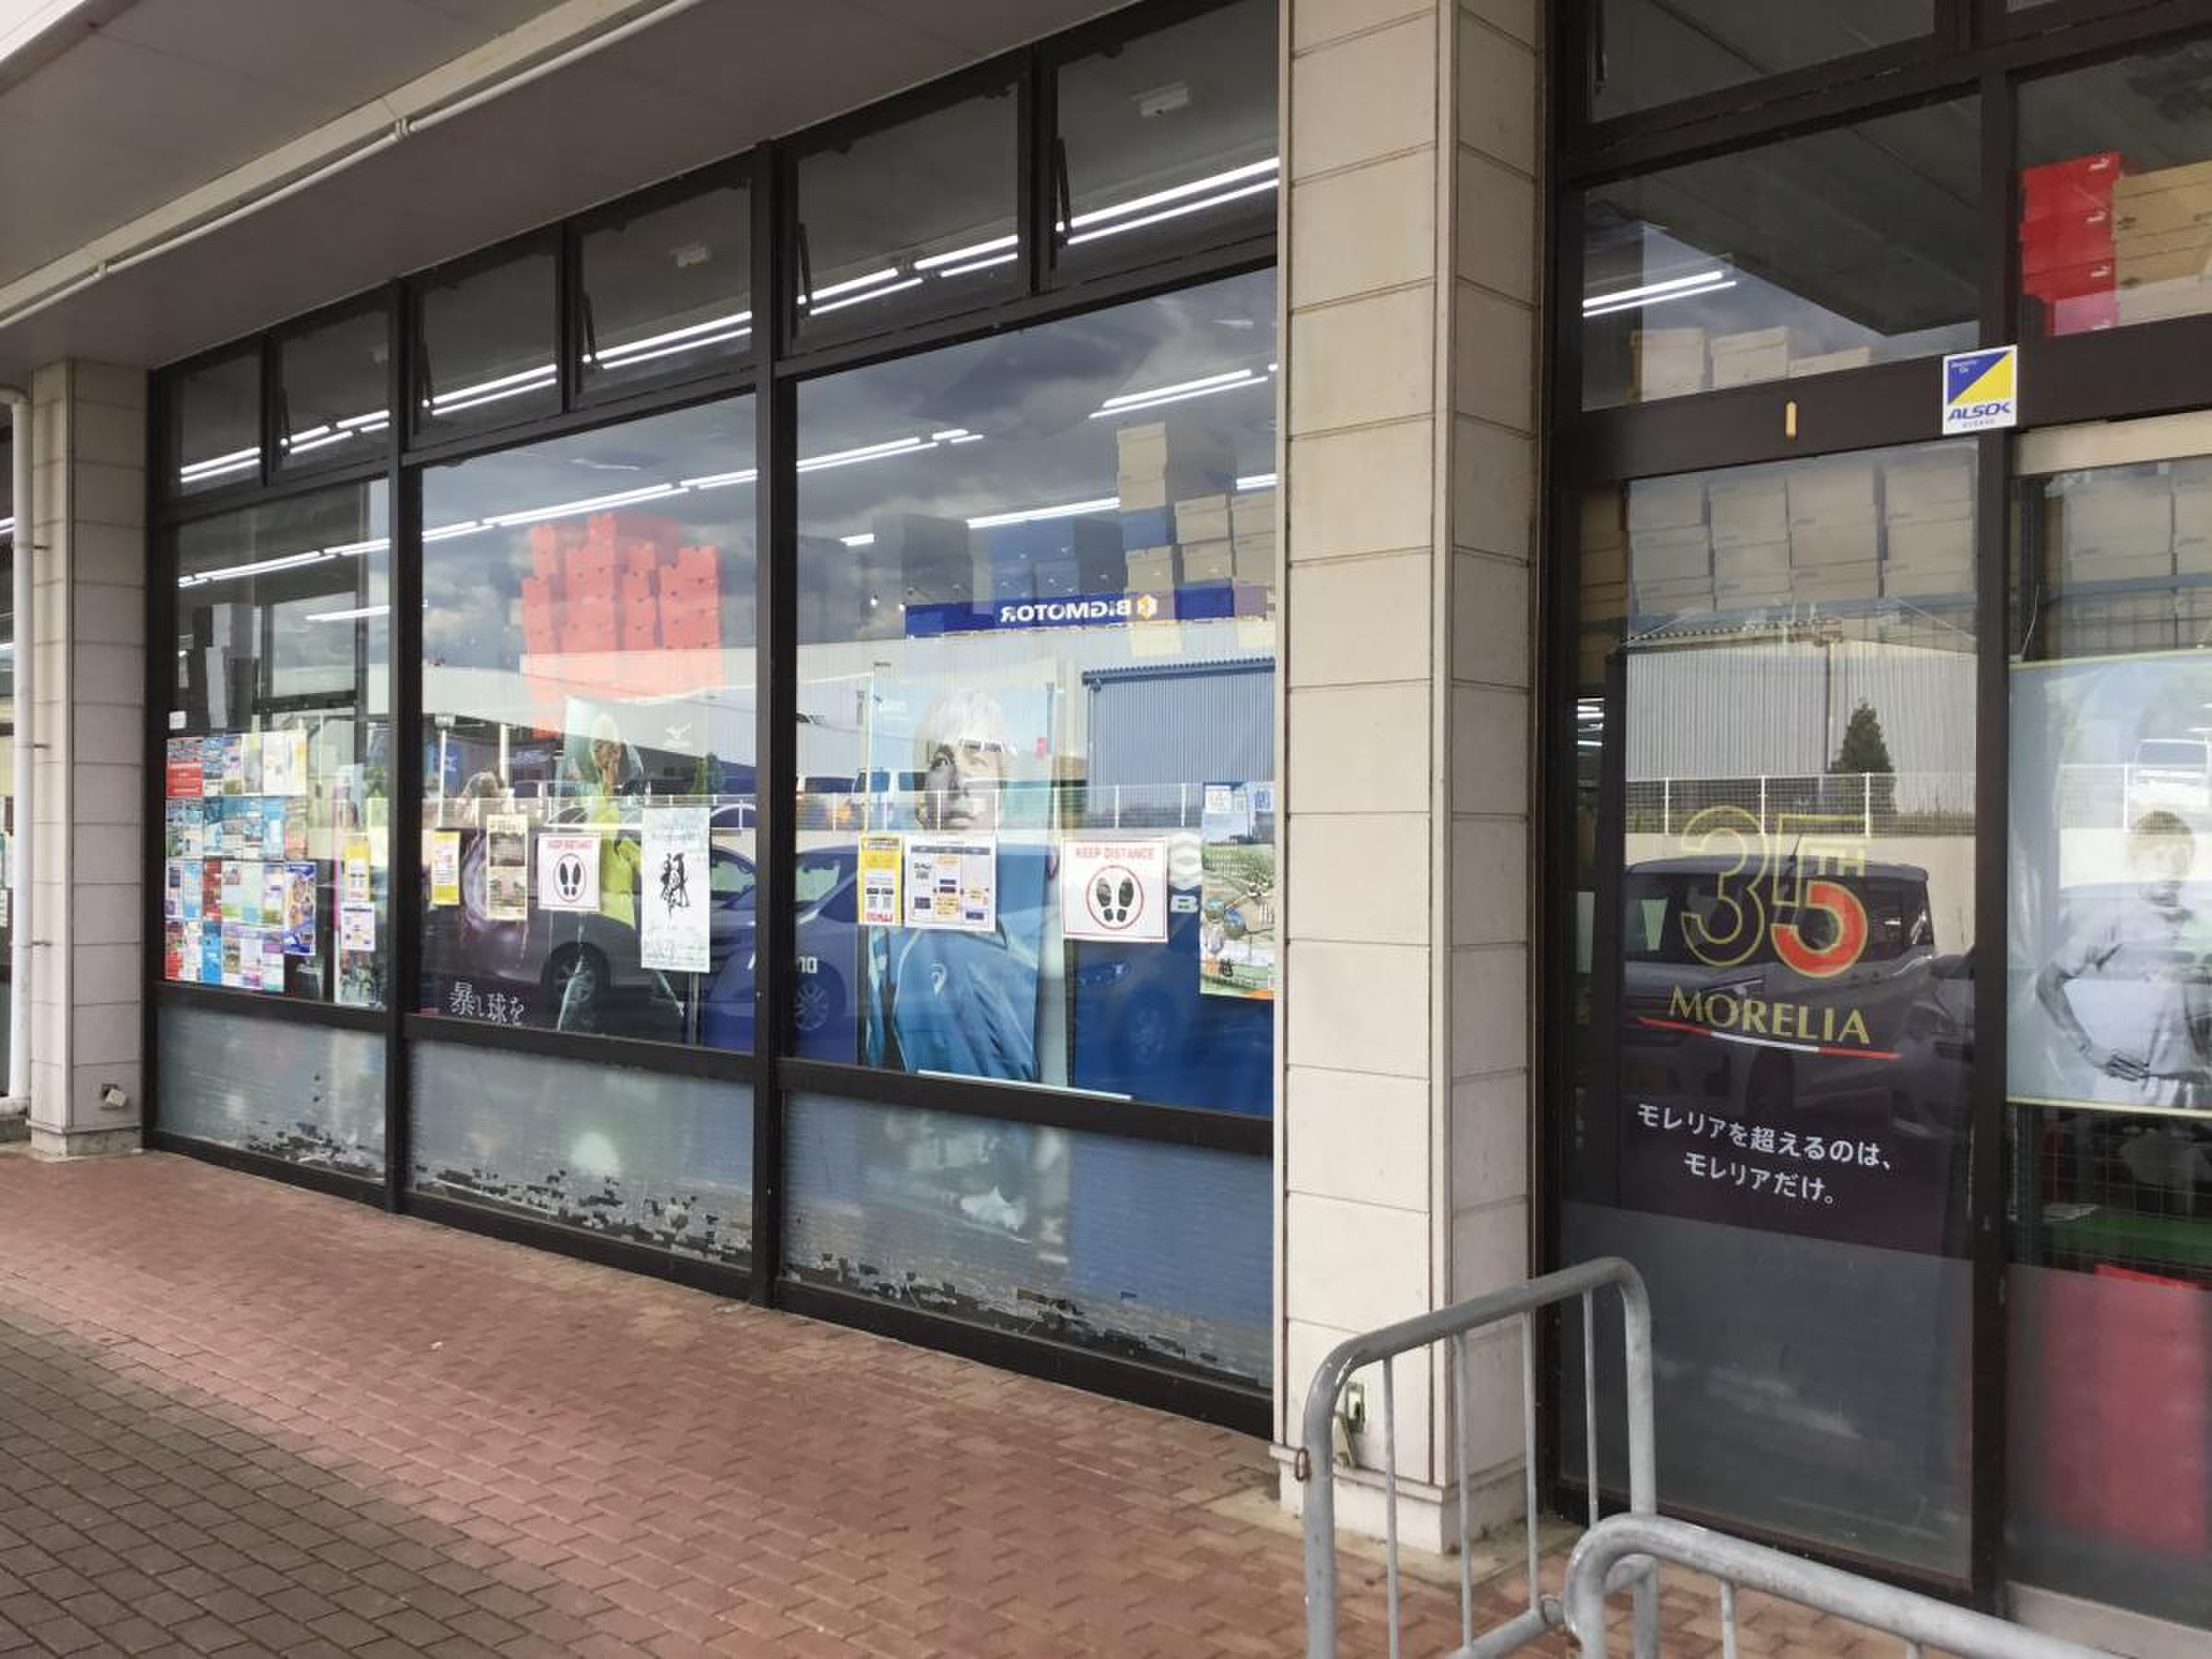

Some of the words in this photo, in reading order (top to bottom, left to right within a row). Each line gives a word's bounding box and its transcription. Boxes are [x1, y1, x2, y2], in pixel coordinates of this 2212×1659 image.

[1947, 402, 2012, 421] ALSOK
[1669, 984, 1871, 1045] MORELIA
[1637, 1103, 1892, 1171] モレリアを超えるのは、
[1684, 1151, 1834, 1206] モレリアだけ。
